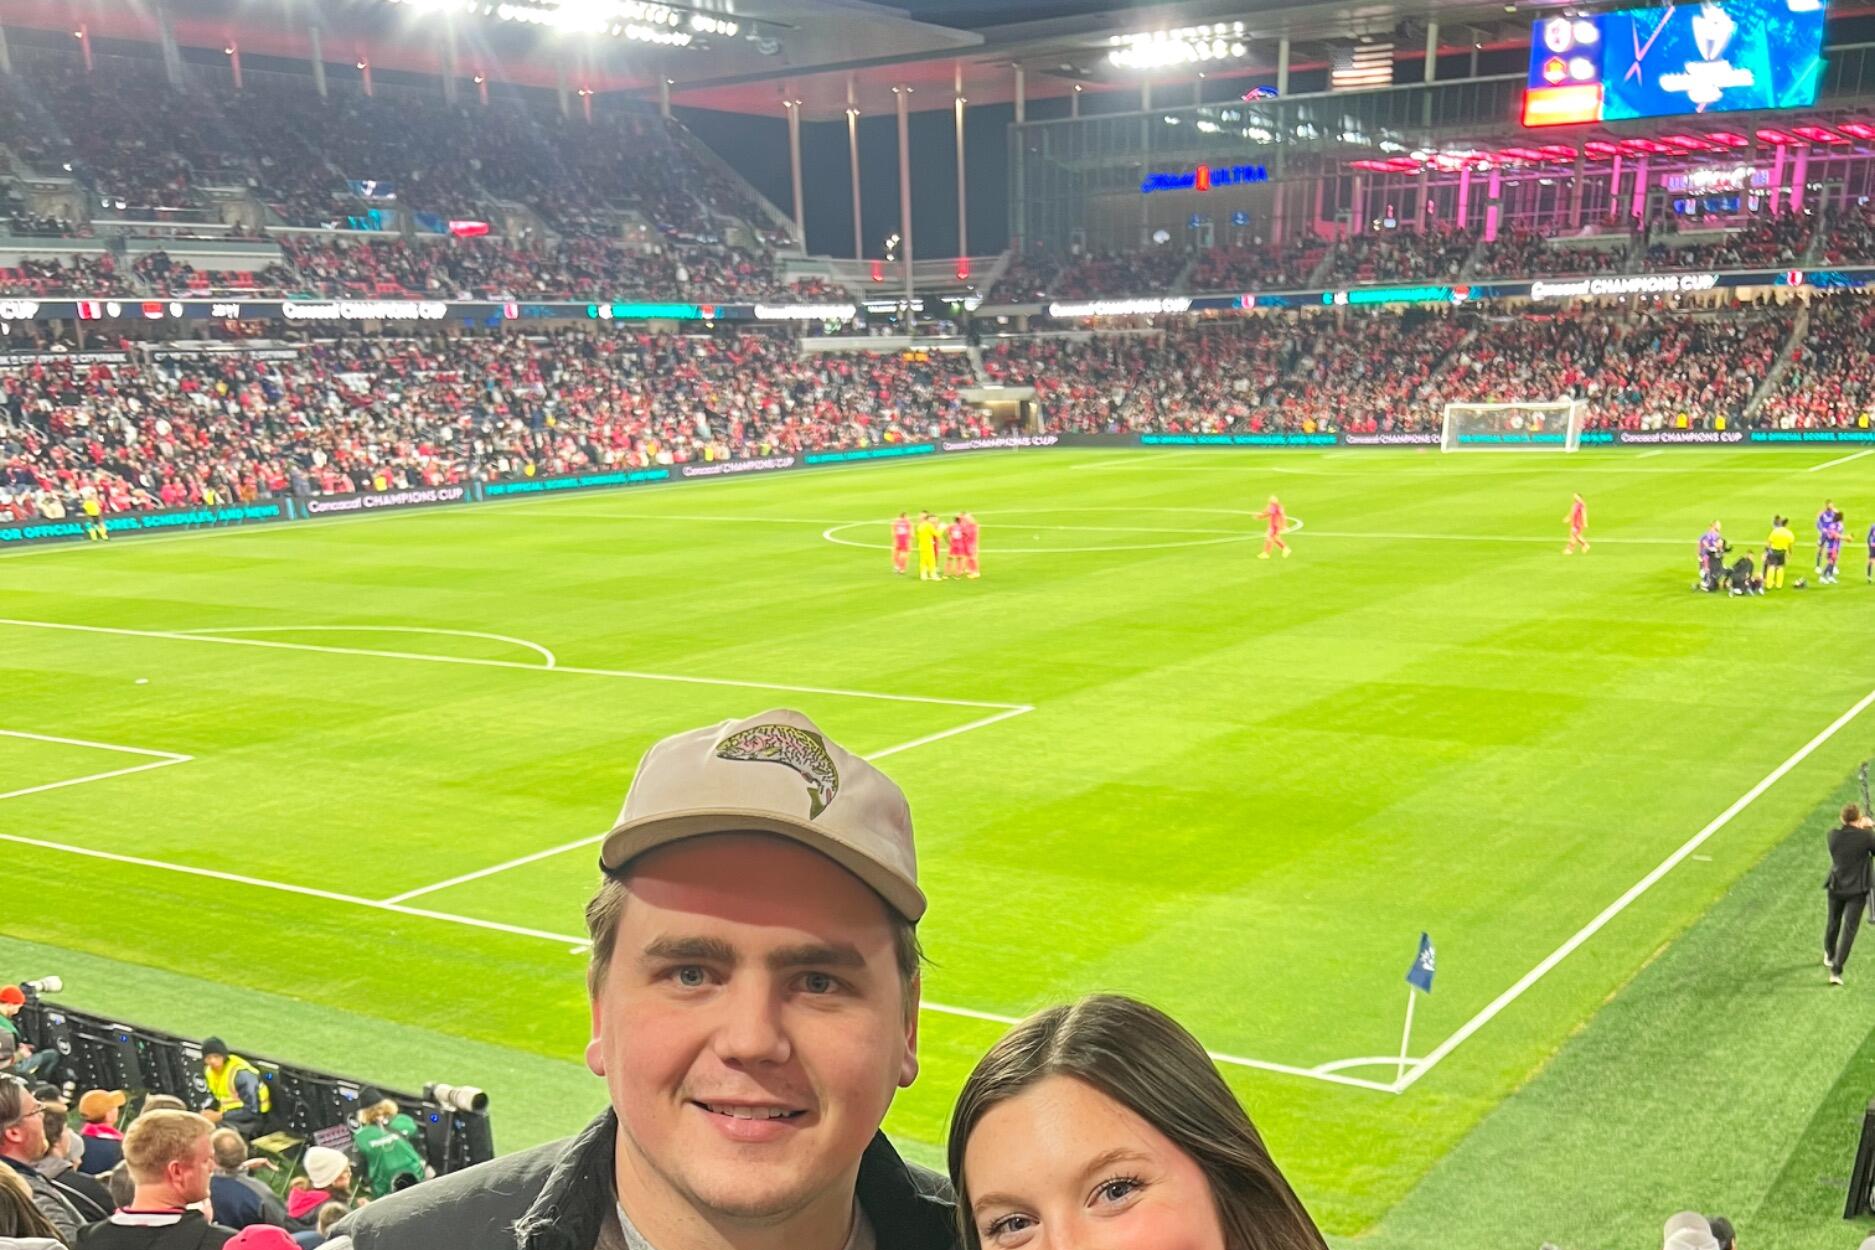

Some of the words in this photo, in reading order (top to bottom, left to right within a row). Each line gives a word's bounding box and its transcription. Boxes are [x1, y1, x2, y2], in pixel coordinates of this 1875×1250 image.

[1591, 275, 1679, 294] CHAMPIONS
[1680, 274, 1715, 290] CUP
[1661, 432, 1719, 442] CHAMPIONS
[1720, 432, 1743, 442] CUP
[363, 490, 437, 508] CHAMPIONS
[437, 487, 463, 500] CUP
[23, 522, 84, 539] OFFICIAL
[85, 516, 142, 533] SORES,
